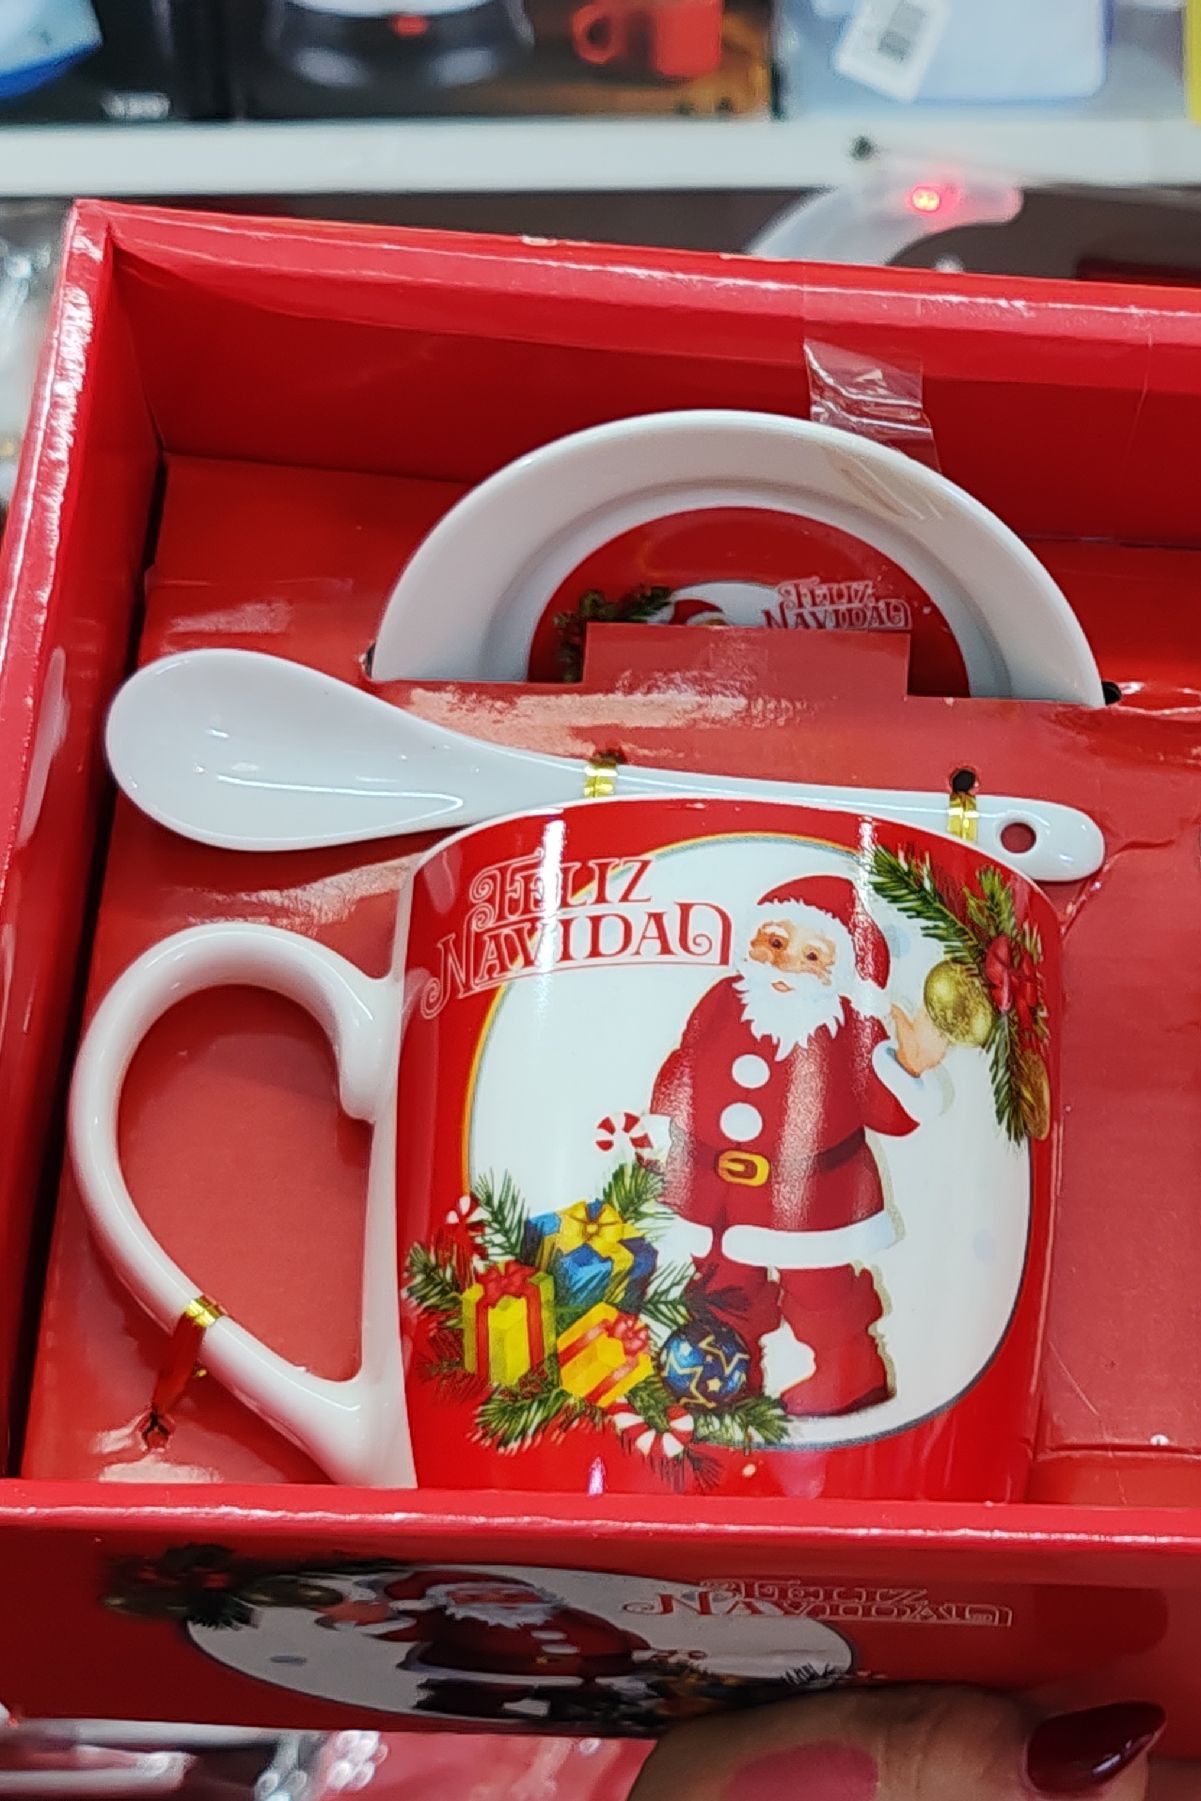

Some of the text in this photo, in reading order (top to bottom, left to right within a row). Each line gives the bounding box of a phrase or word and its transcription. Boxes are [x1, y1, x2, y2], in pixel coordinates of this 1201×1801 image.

[778, 576, 876, 609] FELIZ
[469, 847, 653, 923] FELIZ
[420, 900, 733, 1020] NAVIDAD
